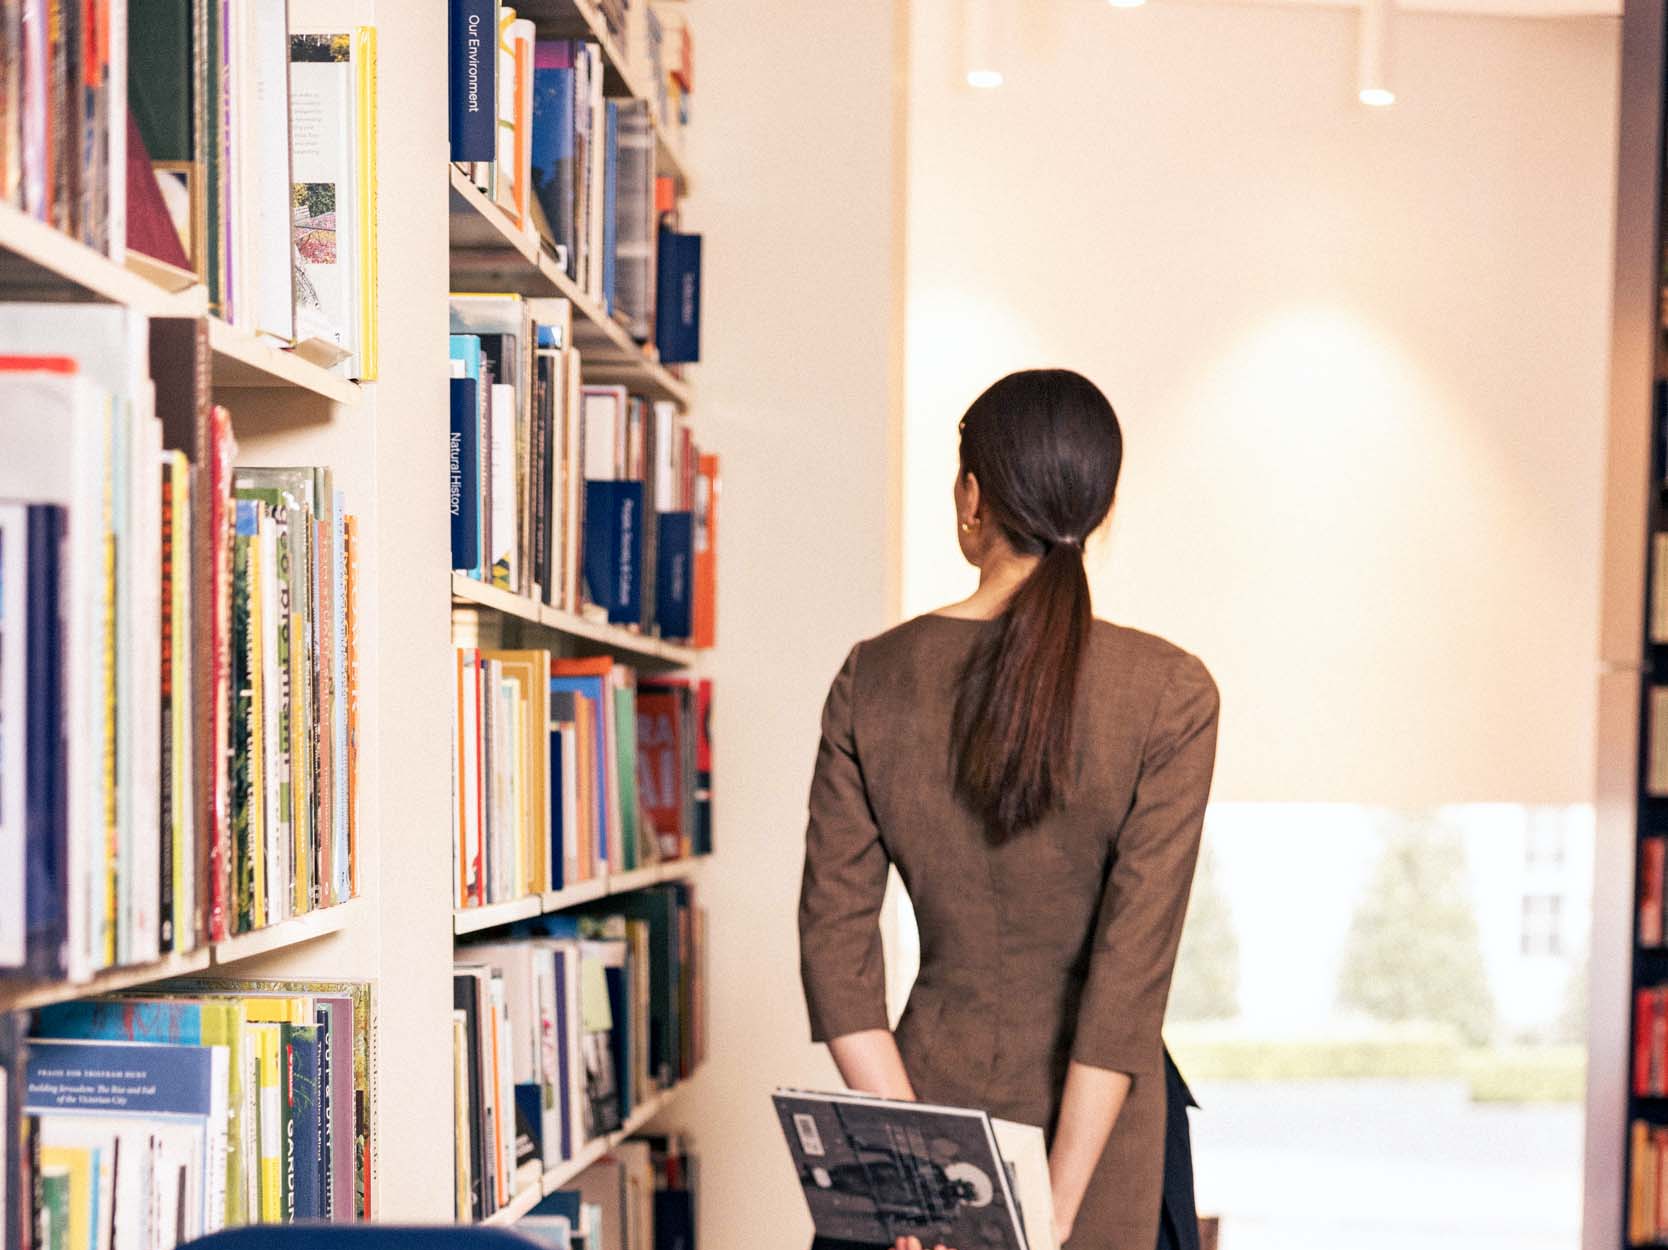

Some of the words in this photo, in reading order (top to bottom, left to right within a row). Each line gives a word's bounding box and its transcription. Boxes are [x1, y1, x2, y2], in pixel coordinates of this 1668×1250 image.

[468, 14, 480, 36] Our
[468, 39, 480, 112] Environment
[450, 432, 461, 474] Natural
[450, 475, 461, 516] History
[287, 1119, 295, 1224] GARDEN
